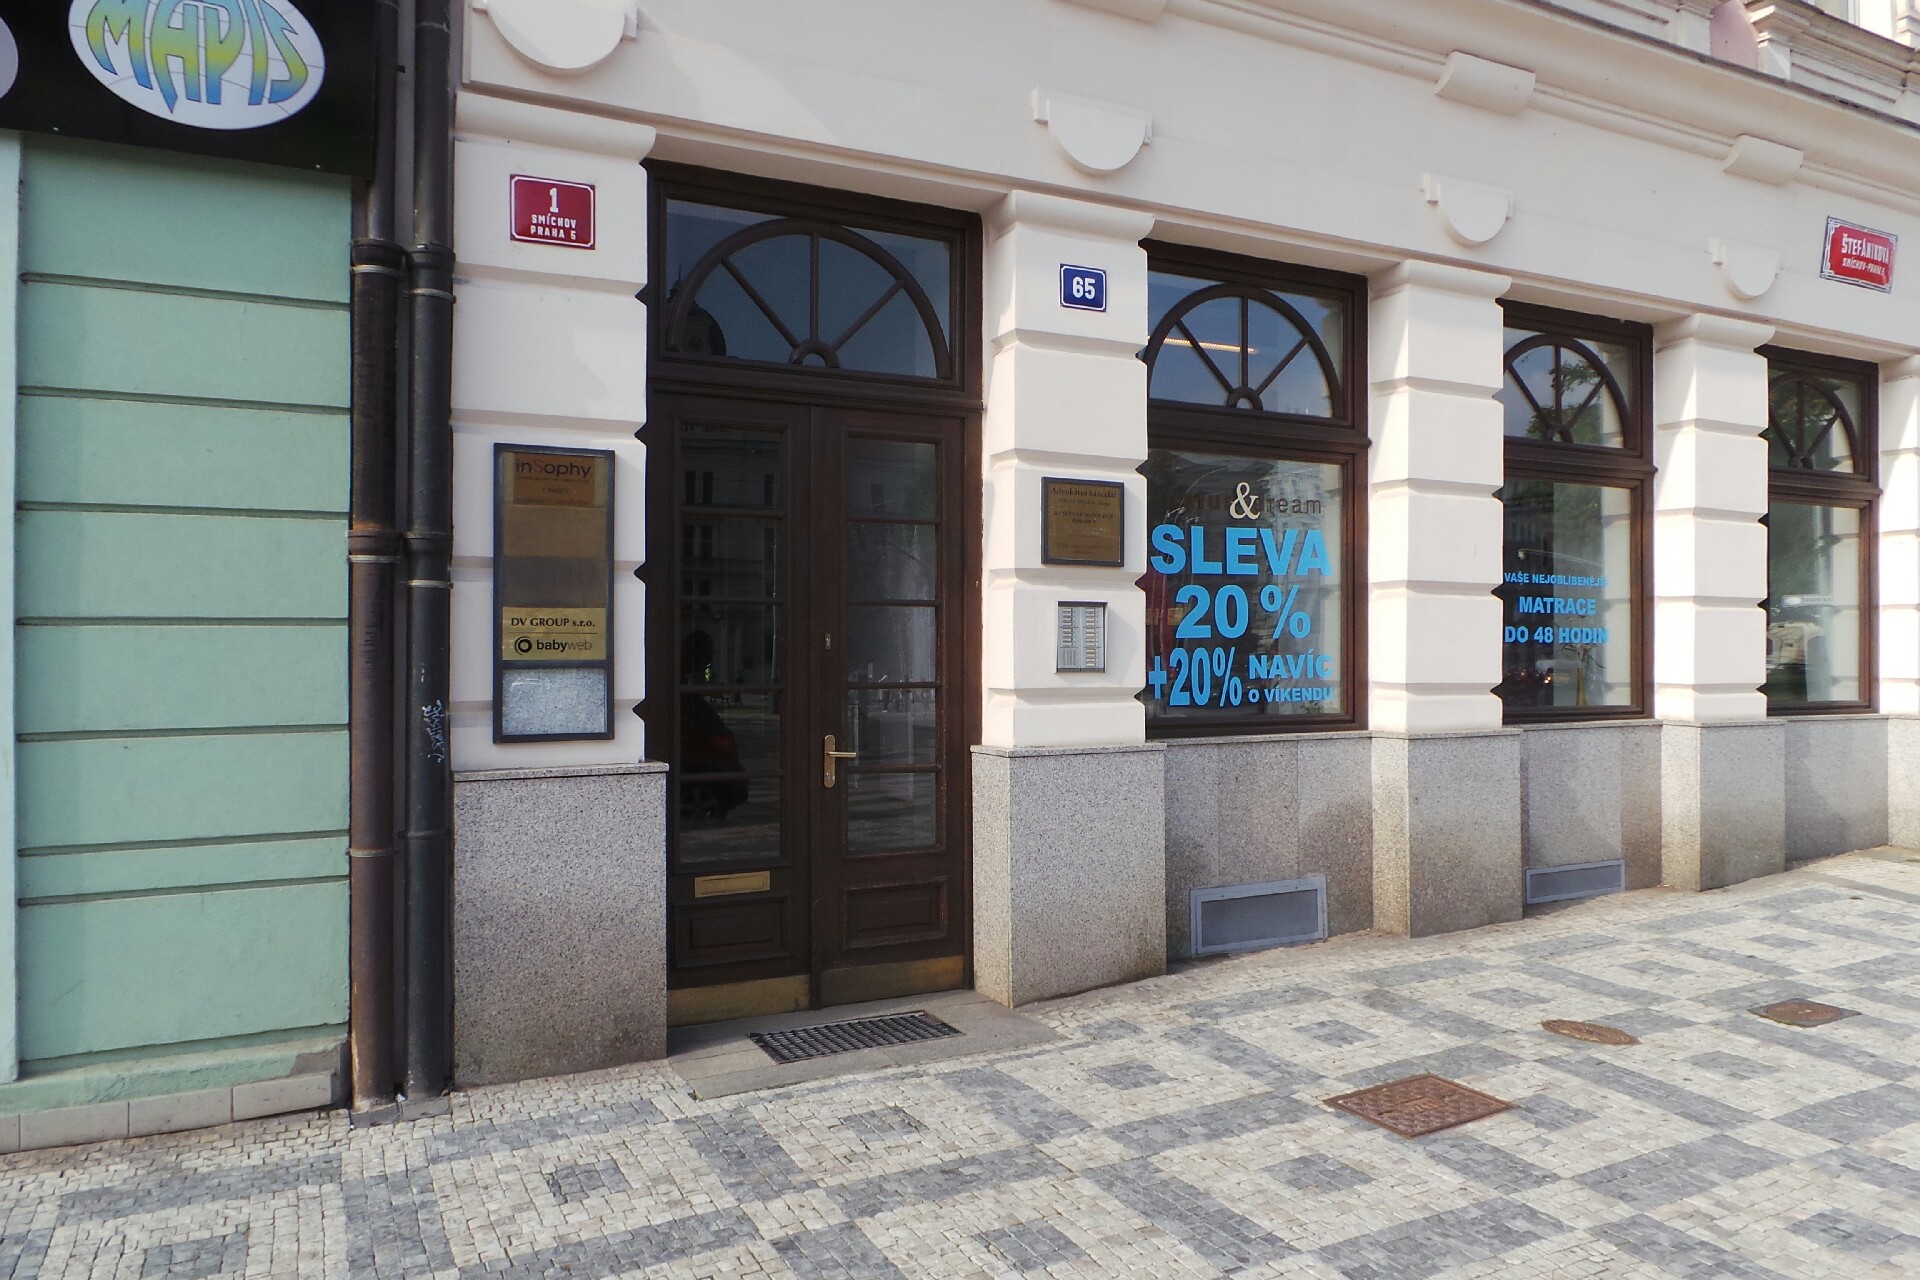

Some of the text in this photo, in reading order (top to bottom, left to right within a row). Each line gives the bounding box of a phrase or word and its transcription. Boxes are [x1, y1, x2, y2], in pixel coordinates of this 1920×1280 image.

[86, 0, 309, 114] MAPIS
[549, 187, 559, 213] 1
[531, 213, 577, 228] SMÍCHOV
[530, 225, 577, 240] PRAHA 5
[1072, 276, 1096, 300] 65
[515, 459, 592, 478] inSophy
[1150, 524, 1333, 575] SLEVA
[1504, 570, 1530, 584] VAŠE
[1175, 584, 1312, 639] 20 %
[1519, 596, 1597, 615] MATRACE
[511, 617, 596, 628] DV GROUP s.r.o.
[1504, 625, 1609, 644] DO 48 HODIN
[536, 638, 593, 652] babyweb
[1148, 647, 1334, 707] +20% NAVÍC
[1264, 685, 1334, 703] VÍKENDU
